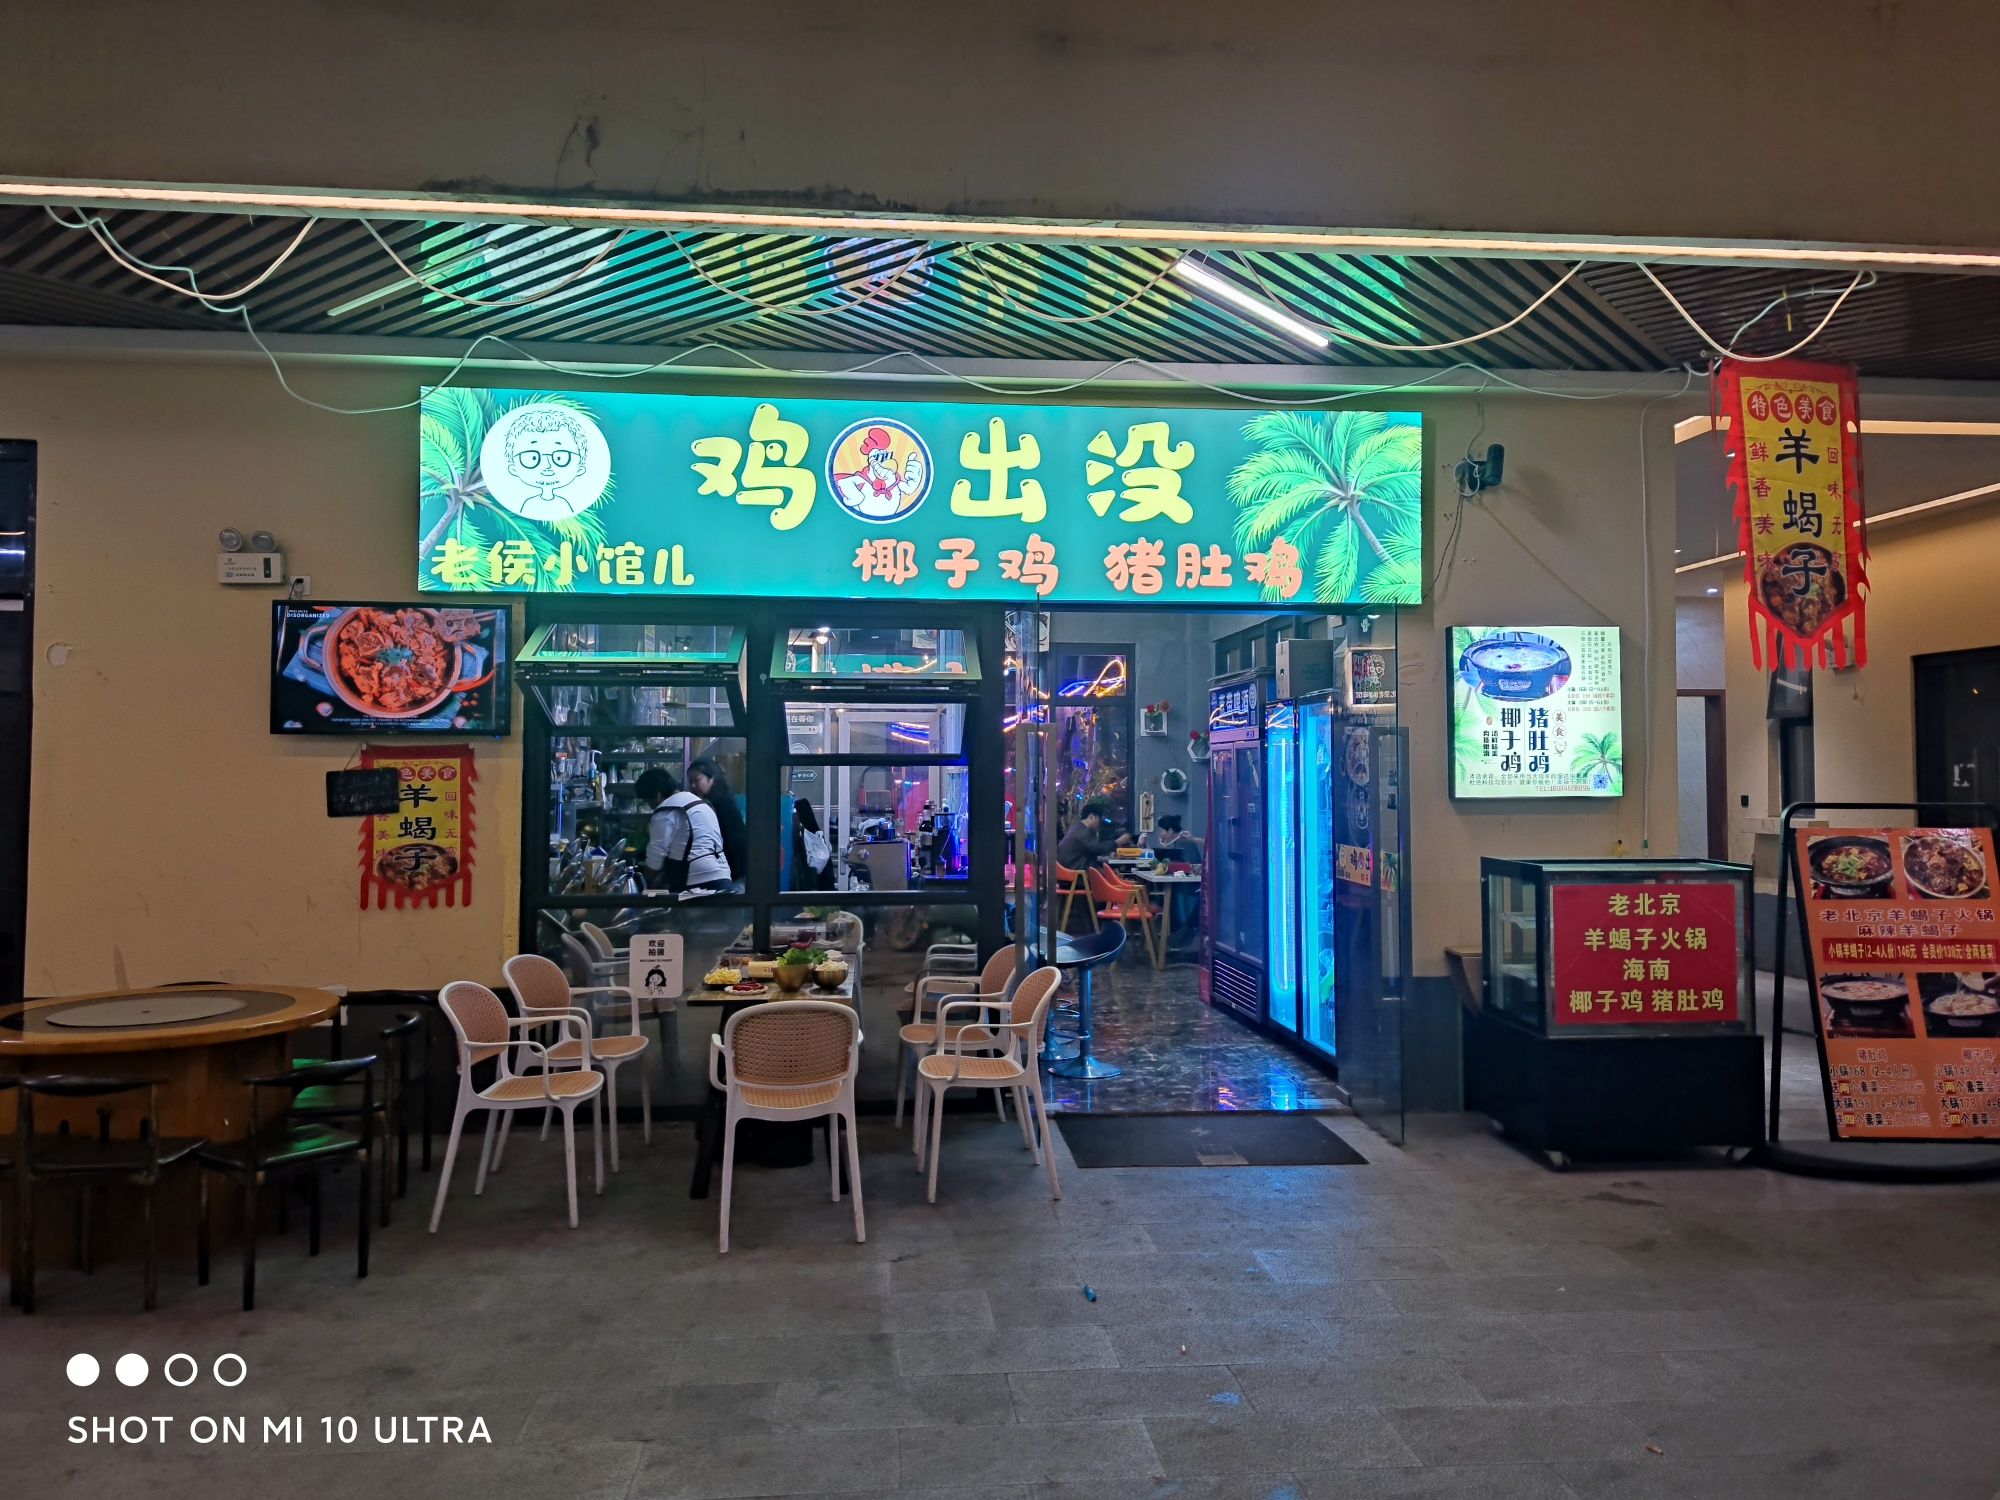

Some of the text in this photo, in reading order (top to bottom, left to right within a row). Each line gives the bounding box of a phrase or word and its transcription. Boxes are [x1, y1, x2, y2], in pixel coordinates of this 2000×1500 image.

[1750, 393, 1836, 423] 特色美食
[1749, 442, 1775, 571] 鲜香美味
[1775, 427, 1828, 597] 羊蝎子
[431, 537, 695, 587] 老侯小馆儿
[852, 533, 1303, 598] 椰子鸡 猪肚鸡
[1554, 711, 1565, 737] 美食
[1500, 707, 1521, 774] 椰子鸡
[1528, 707, 1550, 774] 猪肚鸡
[399, 767, 457, 781] 色美食
[393, 784, 438, 871] 羊蝎子
[1608, 892, 1681, 916] 老北京
[1820, 908, 1995, 922] 老北京羊蝎子火锅
[1584, 927, 1707, 951] 羊蝎子火锅
[1857, 923, 1961, 937] 麻辣羊蝎子
[648, 939, 665, 948] 欢迎
[1623, 957, 1671, 981] 海南
[1569, 988, 1725, 1013] 椰子鸡 猪肚鸡
